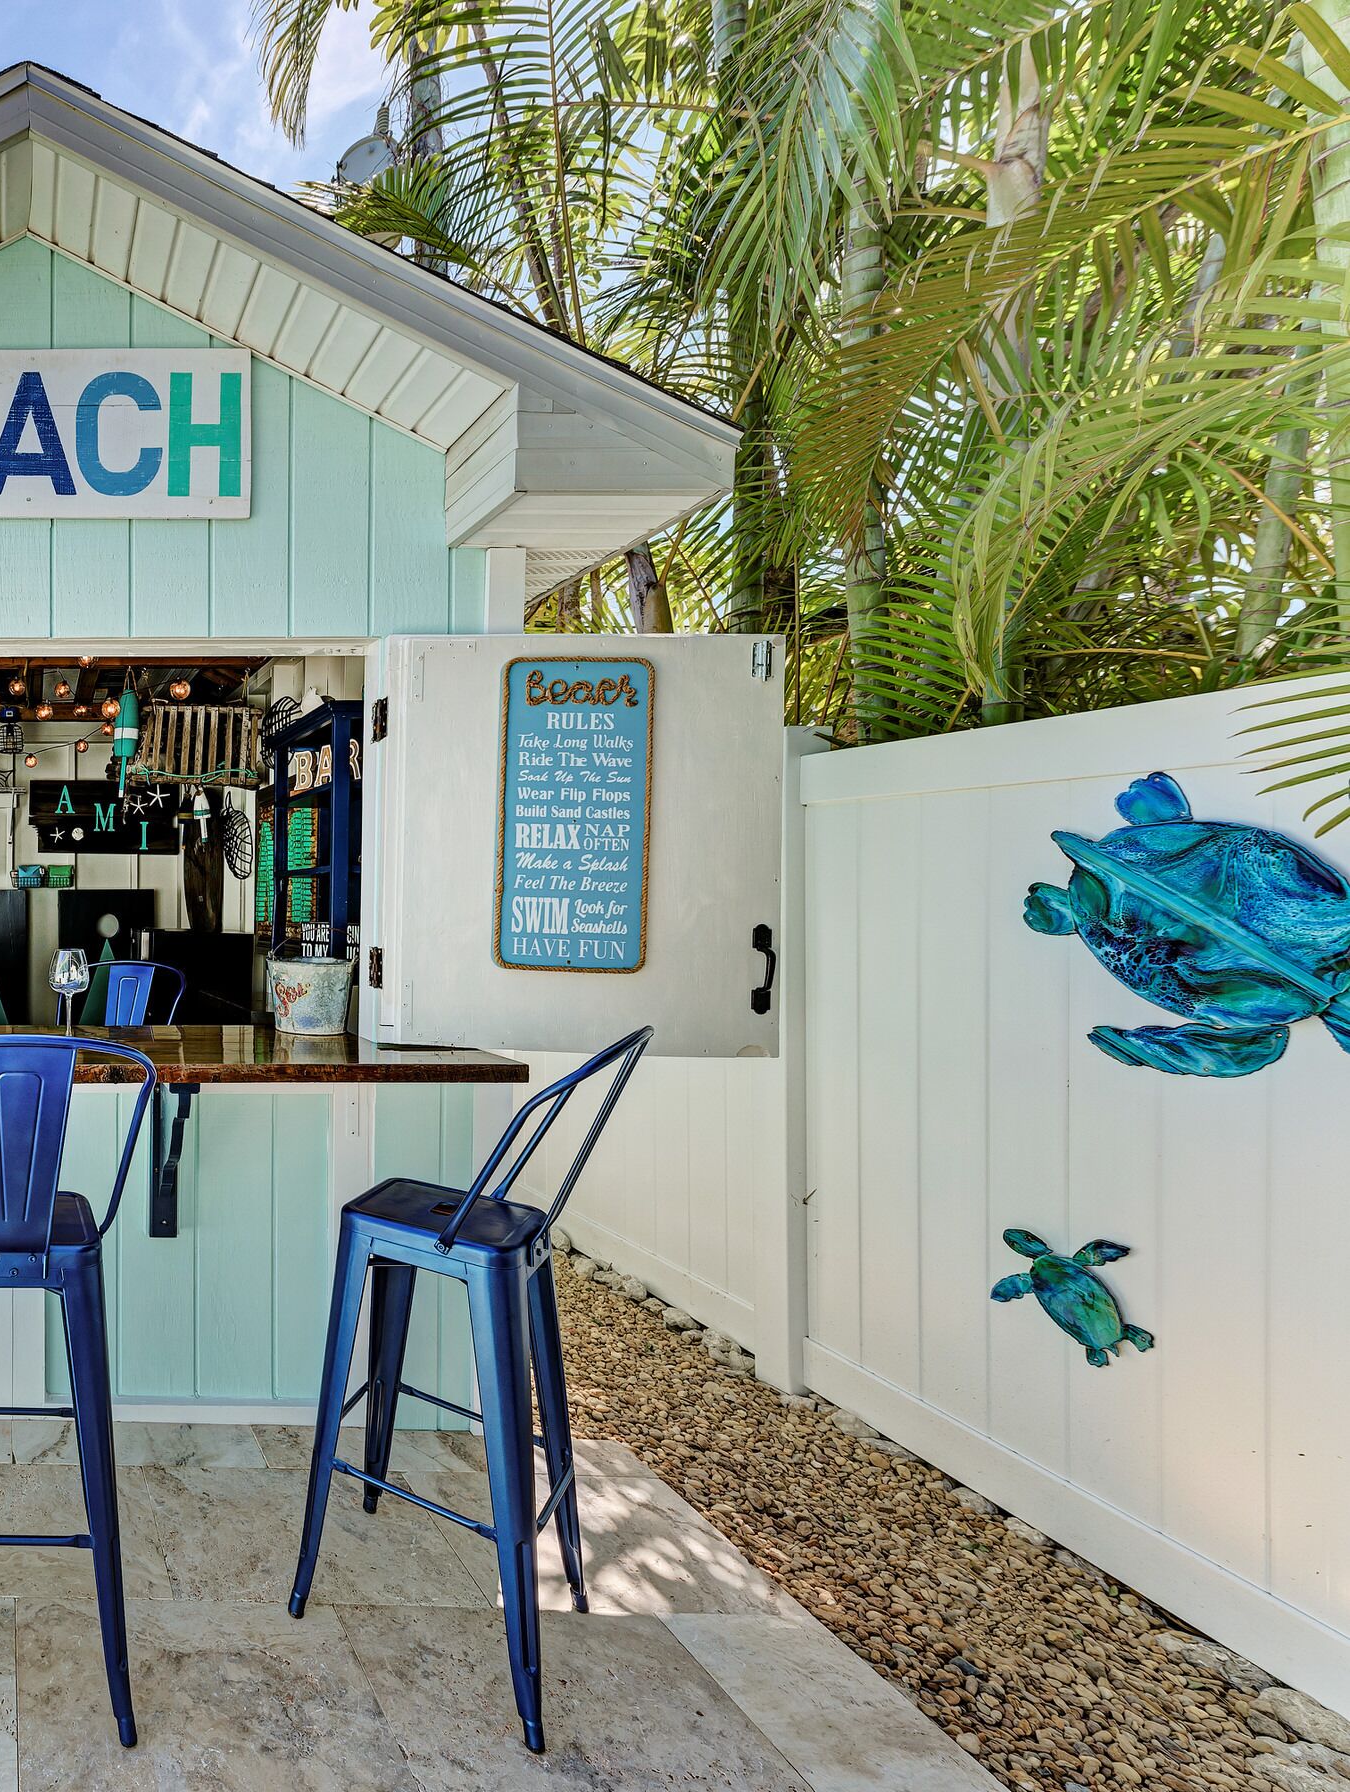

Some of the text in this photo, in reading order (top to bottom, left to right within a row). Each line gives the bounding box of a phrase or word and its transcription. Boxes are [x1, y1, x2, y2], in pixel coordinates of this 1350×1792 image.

[546, 712, 615, 730] RULES
[517, 732, 634, 752] Take Long Walks
[518, 751, 633, 768] Ride The Wave
[517, 769, 633, 784] Soak Up The Sun
[517, 786, 631, 804] Wear Flip Flops
[515, 804, 630, 820] Build Sand Castles
[514, 823, 581, 850] RELAX
[584, 823, 630, 837] NAP
[583, 837, 630, 851] OFTEN
[515, 851, 629, 875] Make a Splash
[513, 874, 628, 893] Feel The Breeze
[511, 895, 570, 935] SWIM
[574, 898, 628, 919] Look for
[301, 923, 315, 942] YOU
[316, 924, 330, 943] ARE
[570, 918, 628, 935] Seashells
[301, 943, 329, 957] TO MY
[511, 937, 627, 960] HAVE FUN
